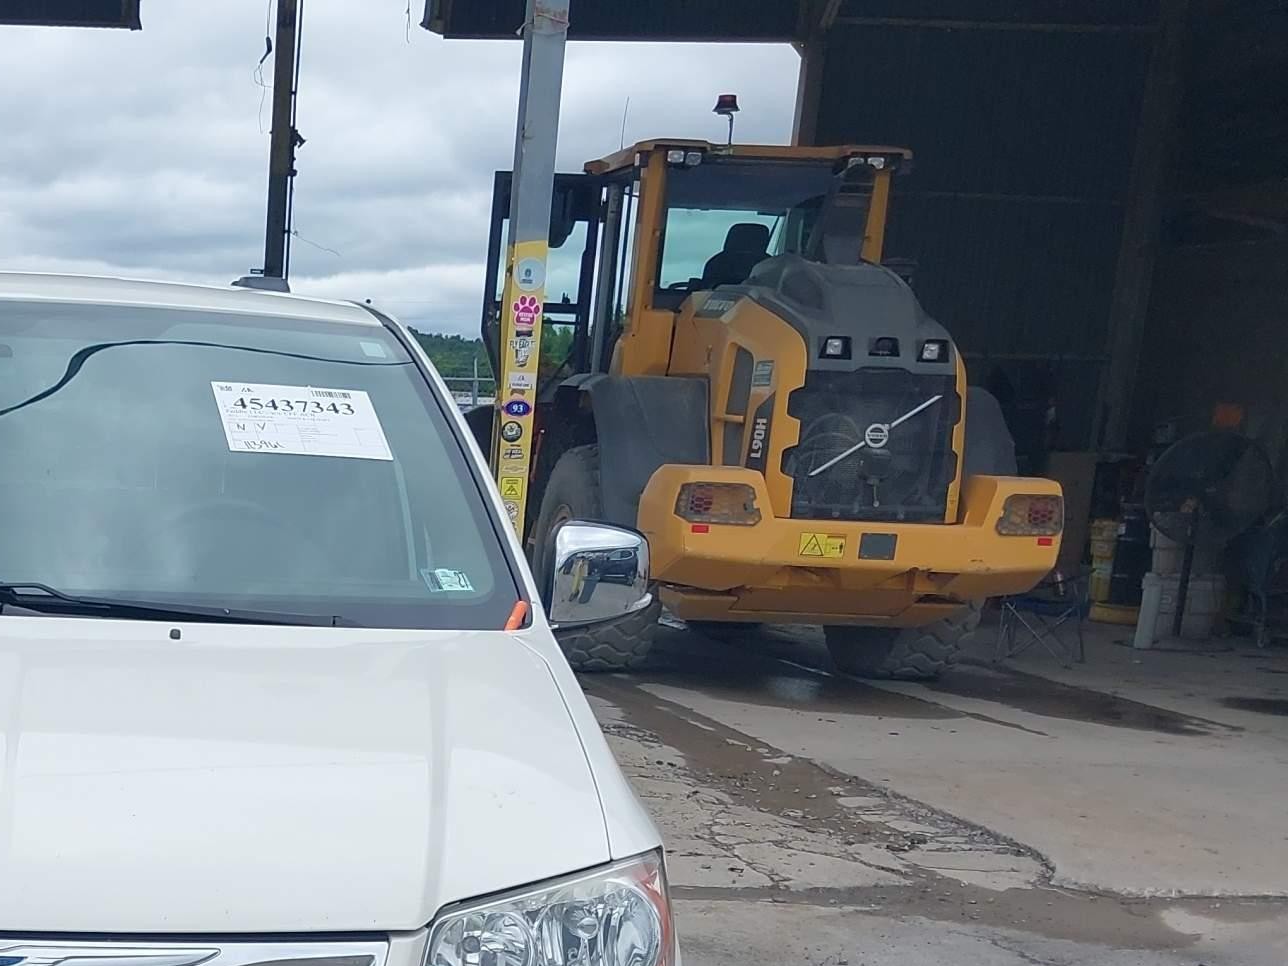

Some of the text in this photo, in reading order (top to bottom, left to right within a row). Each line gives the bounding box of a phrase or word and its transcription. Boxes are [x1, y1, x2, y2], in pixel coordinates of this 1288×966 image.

[233, 397, 355, 416] 45437343
[512, 404, 524, 413] 93
[750, 418, 768, 459] L90H
